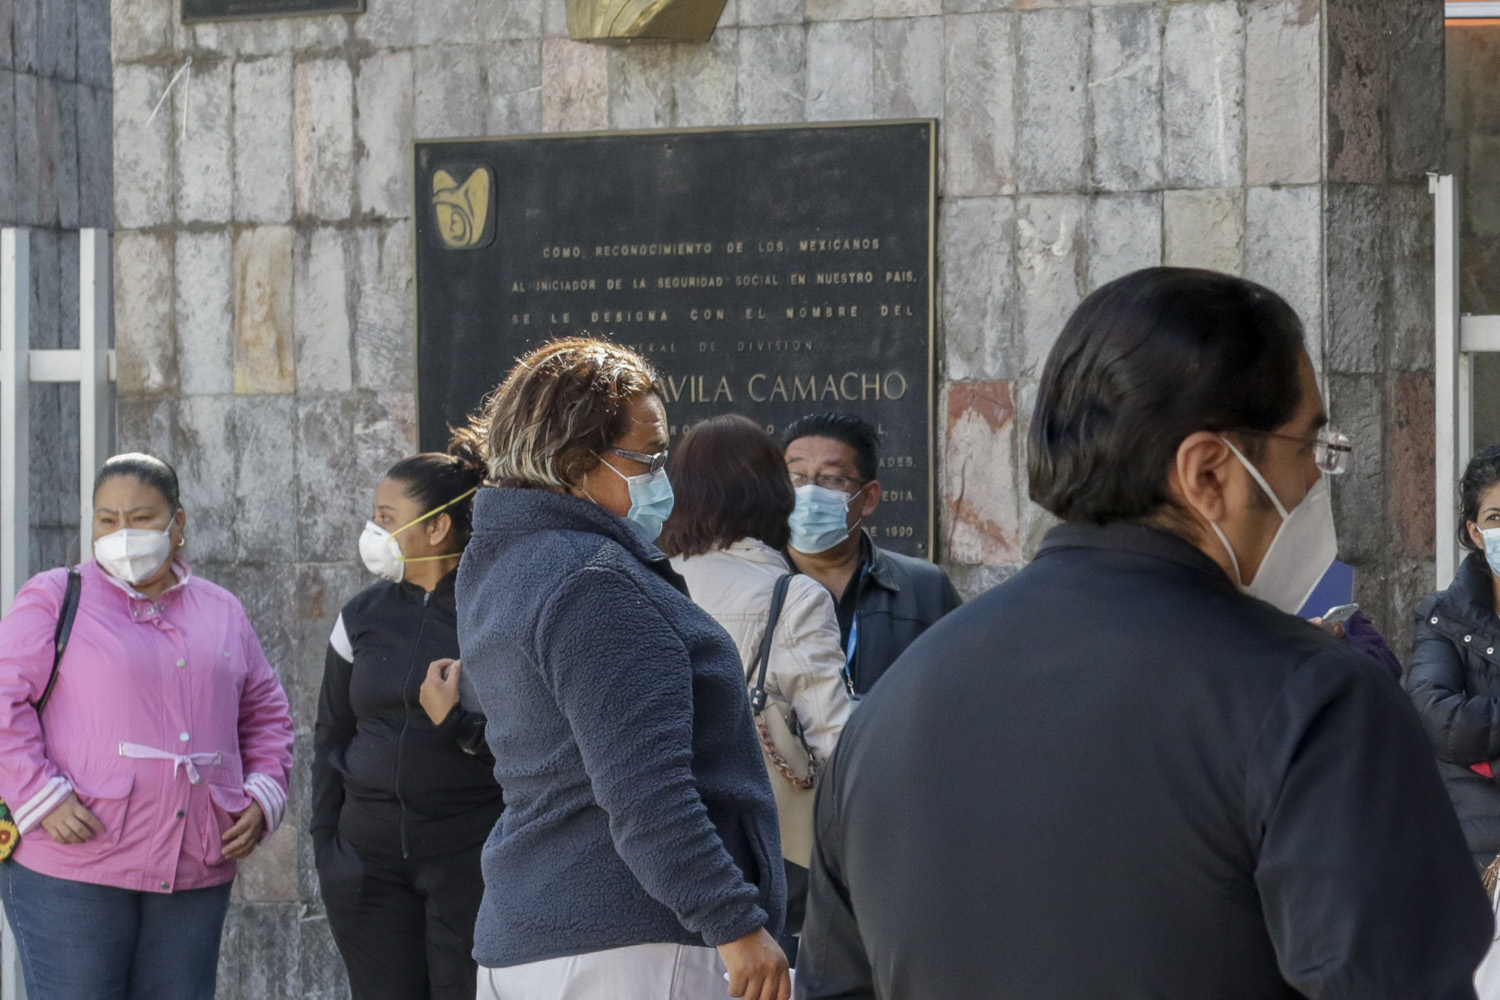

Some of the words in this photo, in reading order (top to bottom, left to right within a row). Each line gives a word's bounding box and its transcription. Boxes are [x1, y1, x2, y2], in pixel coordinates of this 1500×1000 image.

[543, 246, 580, 258] COMO
[596, 242, 712, 256] RECONOCIMIENTO
[727, 242, 743, 253] DE
[759, 241, 783, 252] LOS
[800, 239, 879, 251] MEXICANOS
[512, 281, 525, 293] AL
[536, 280, 596, 292] INICIADOR
[607, 279, 622, 290] DE
[633, 278, 646, 289] LA
[658, 276, 723, 288] SEGURIDAD
[736, 275, 778, 287] SOCIAL
[791, 274, 805, 285] EN
[817, 272, 873, 284] NUESTRO
[512, 313, 530, 324] SE
[552, 313, 570, 324] LE
[591, 311, 667, 323] DESIGNA
[691, 309, 724, 320] CON
[746, 308, 765, 319] EL
[786, 306, 857, 319] NOMBRE
[881, 305, 913, 316] DEL
[700, 342, 716, 353] DE
[737, 340, 813, 352] DIVISION
[748, 372, 907, 402] CAMACHO
